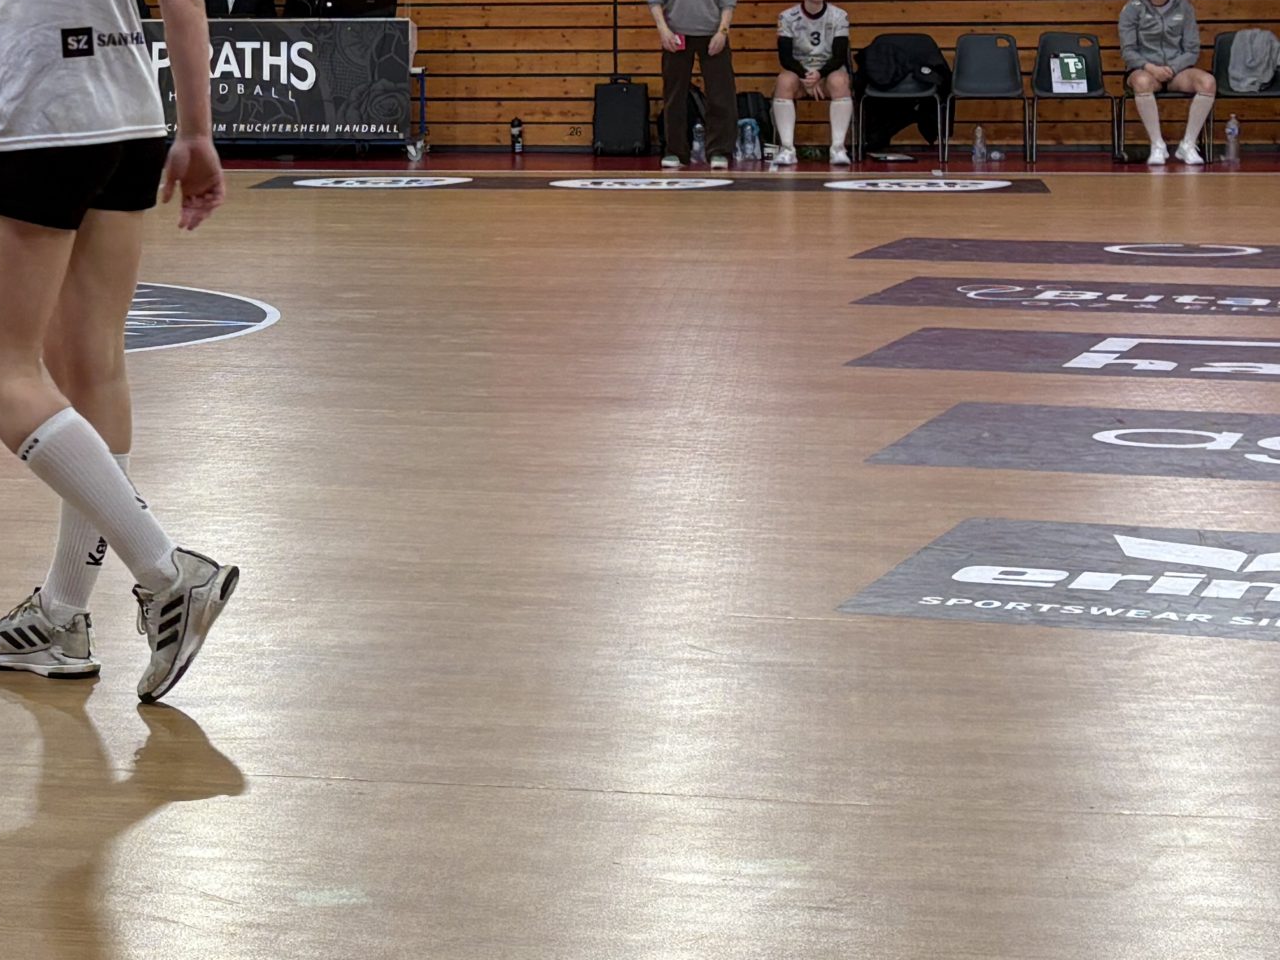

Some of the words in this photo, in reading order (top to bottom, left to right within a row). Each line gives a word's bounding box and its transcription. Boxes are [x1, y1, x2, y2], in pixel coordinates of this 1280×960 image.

[67, 34, 89, 50] SZ
[810, 31, 822, 46] 3
[169, 83, 296, 102] HDBALL
[232, 124, 330, 133] TRUCHTERSHEIM
[335, 124, 400, 133] HANDBALL
[918, 595, 1212, 623] SPORTSWEAR
